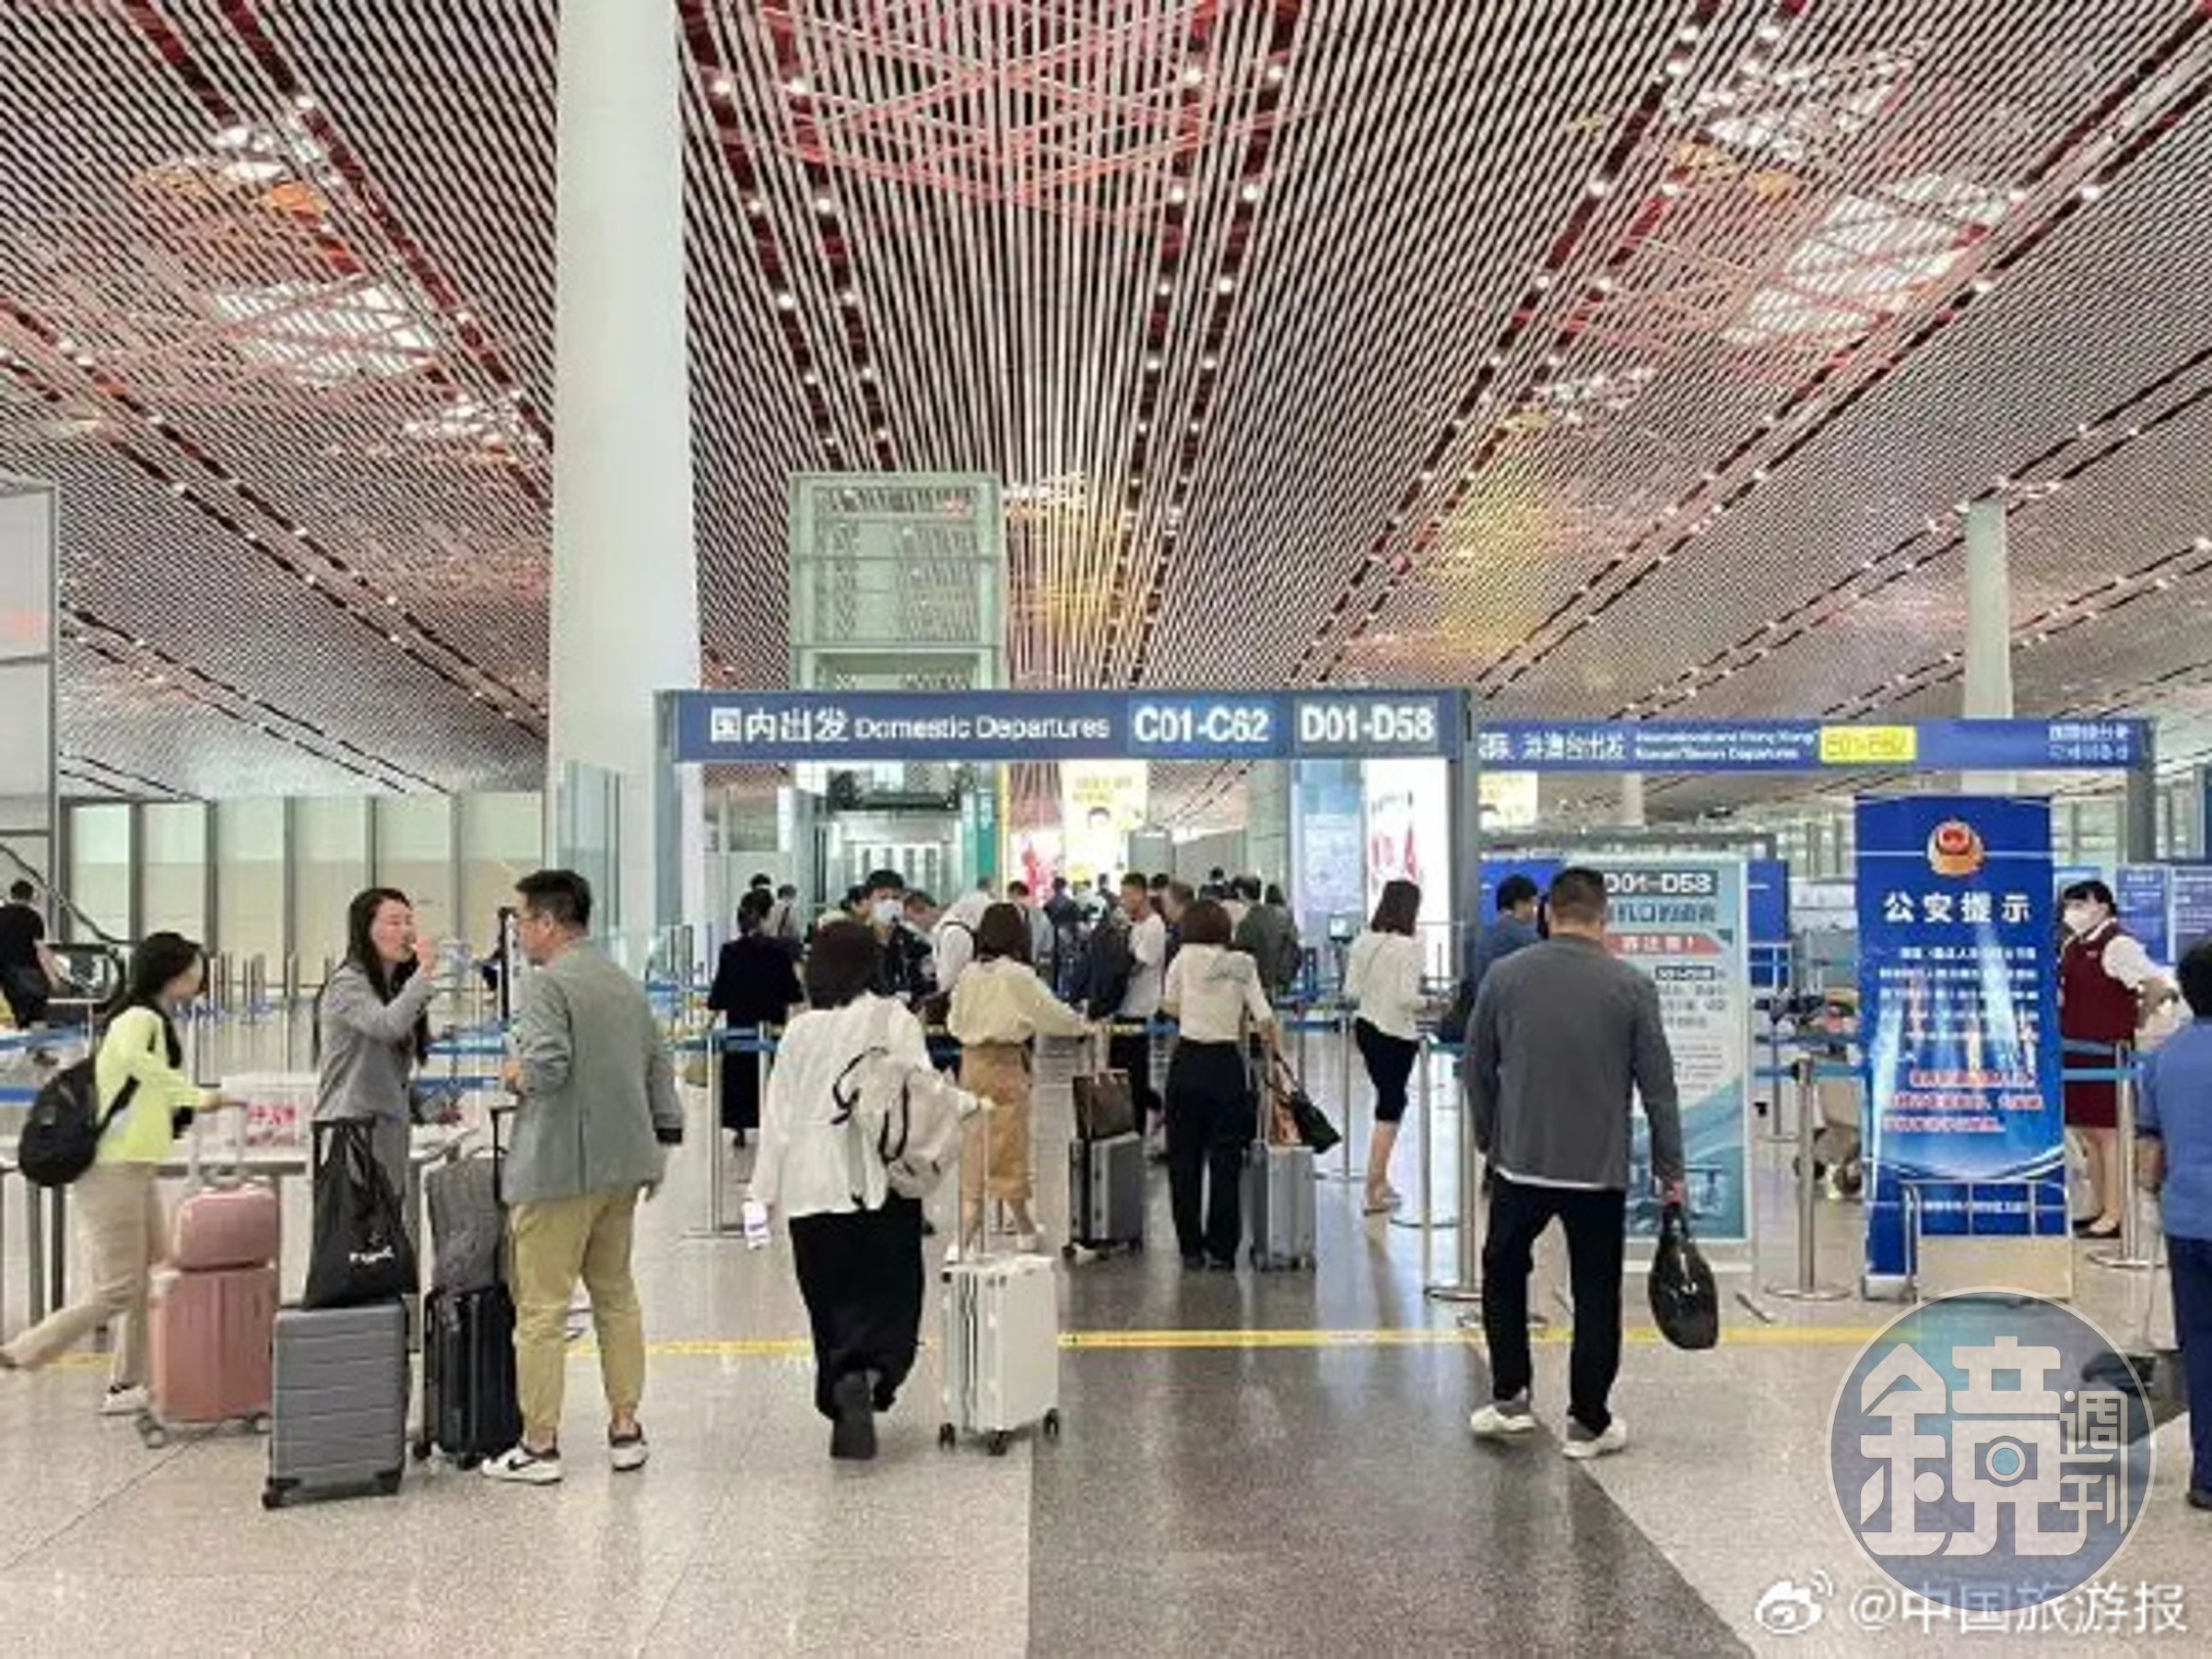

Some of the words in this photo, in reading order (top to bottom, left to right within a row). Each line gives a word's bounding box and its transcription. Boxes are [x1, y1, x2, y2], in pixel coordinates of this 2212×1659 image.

[710, 707, 850, 742] 国内出发
[854, 715, 971, 738] Domestic
[975, 715, 1111, 741] Departures
[1134, 703, 1270, 743] C01-C62
[1300, 703, 1435, 743] D01-D58
[1884, 890, 2031, 923] 公安提示
